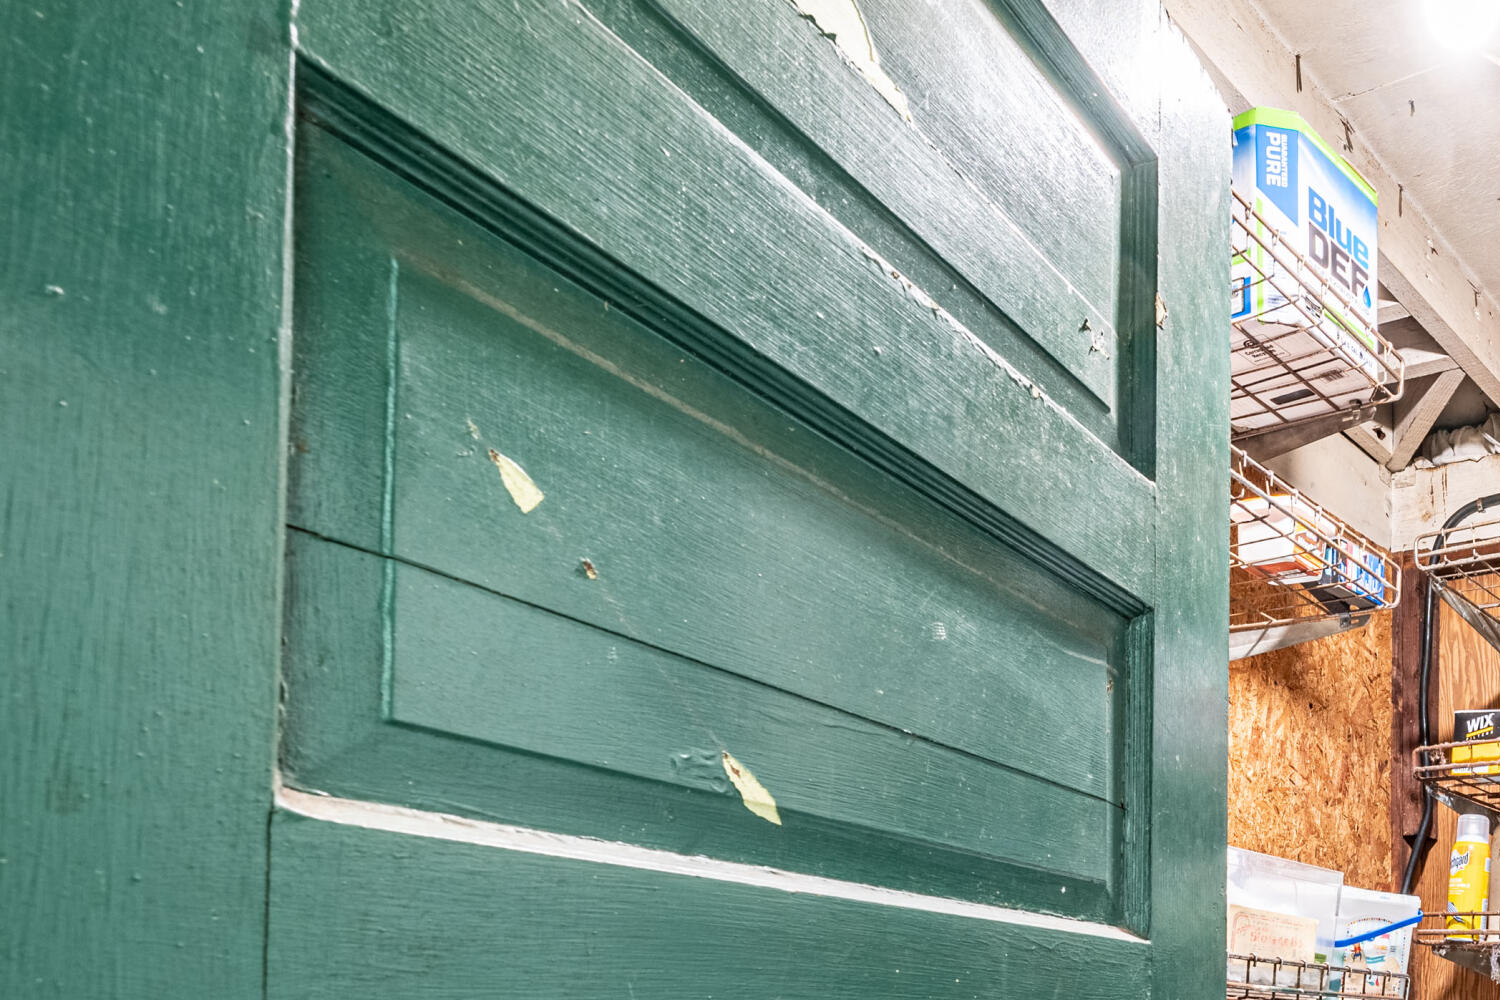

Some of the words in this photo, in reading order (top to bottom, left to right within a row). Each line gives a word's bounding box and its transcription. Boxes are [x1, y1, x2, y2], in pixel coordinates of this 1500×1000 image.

[1265, 131, 1281, 187] PURE
[1308, 186, 1369, 270] Blue
[1308, 221, 1369, 297] DEF
[1466, 713, 1495, 733] WIX
